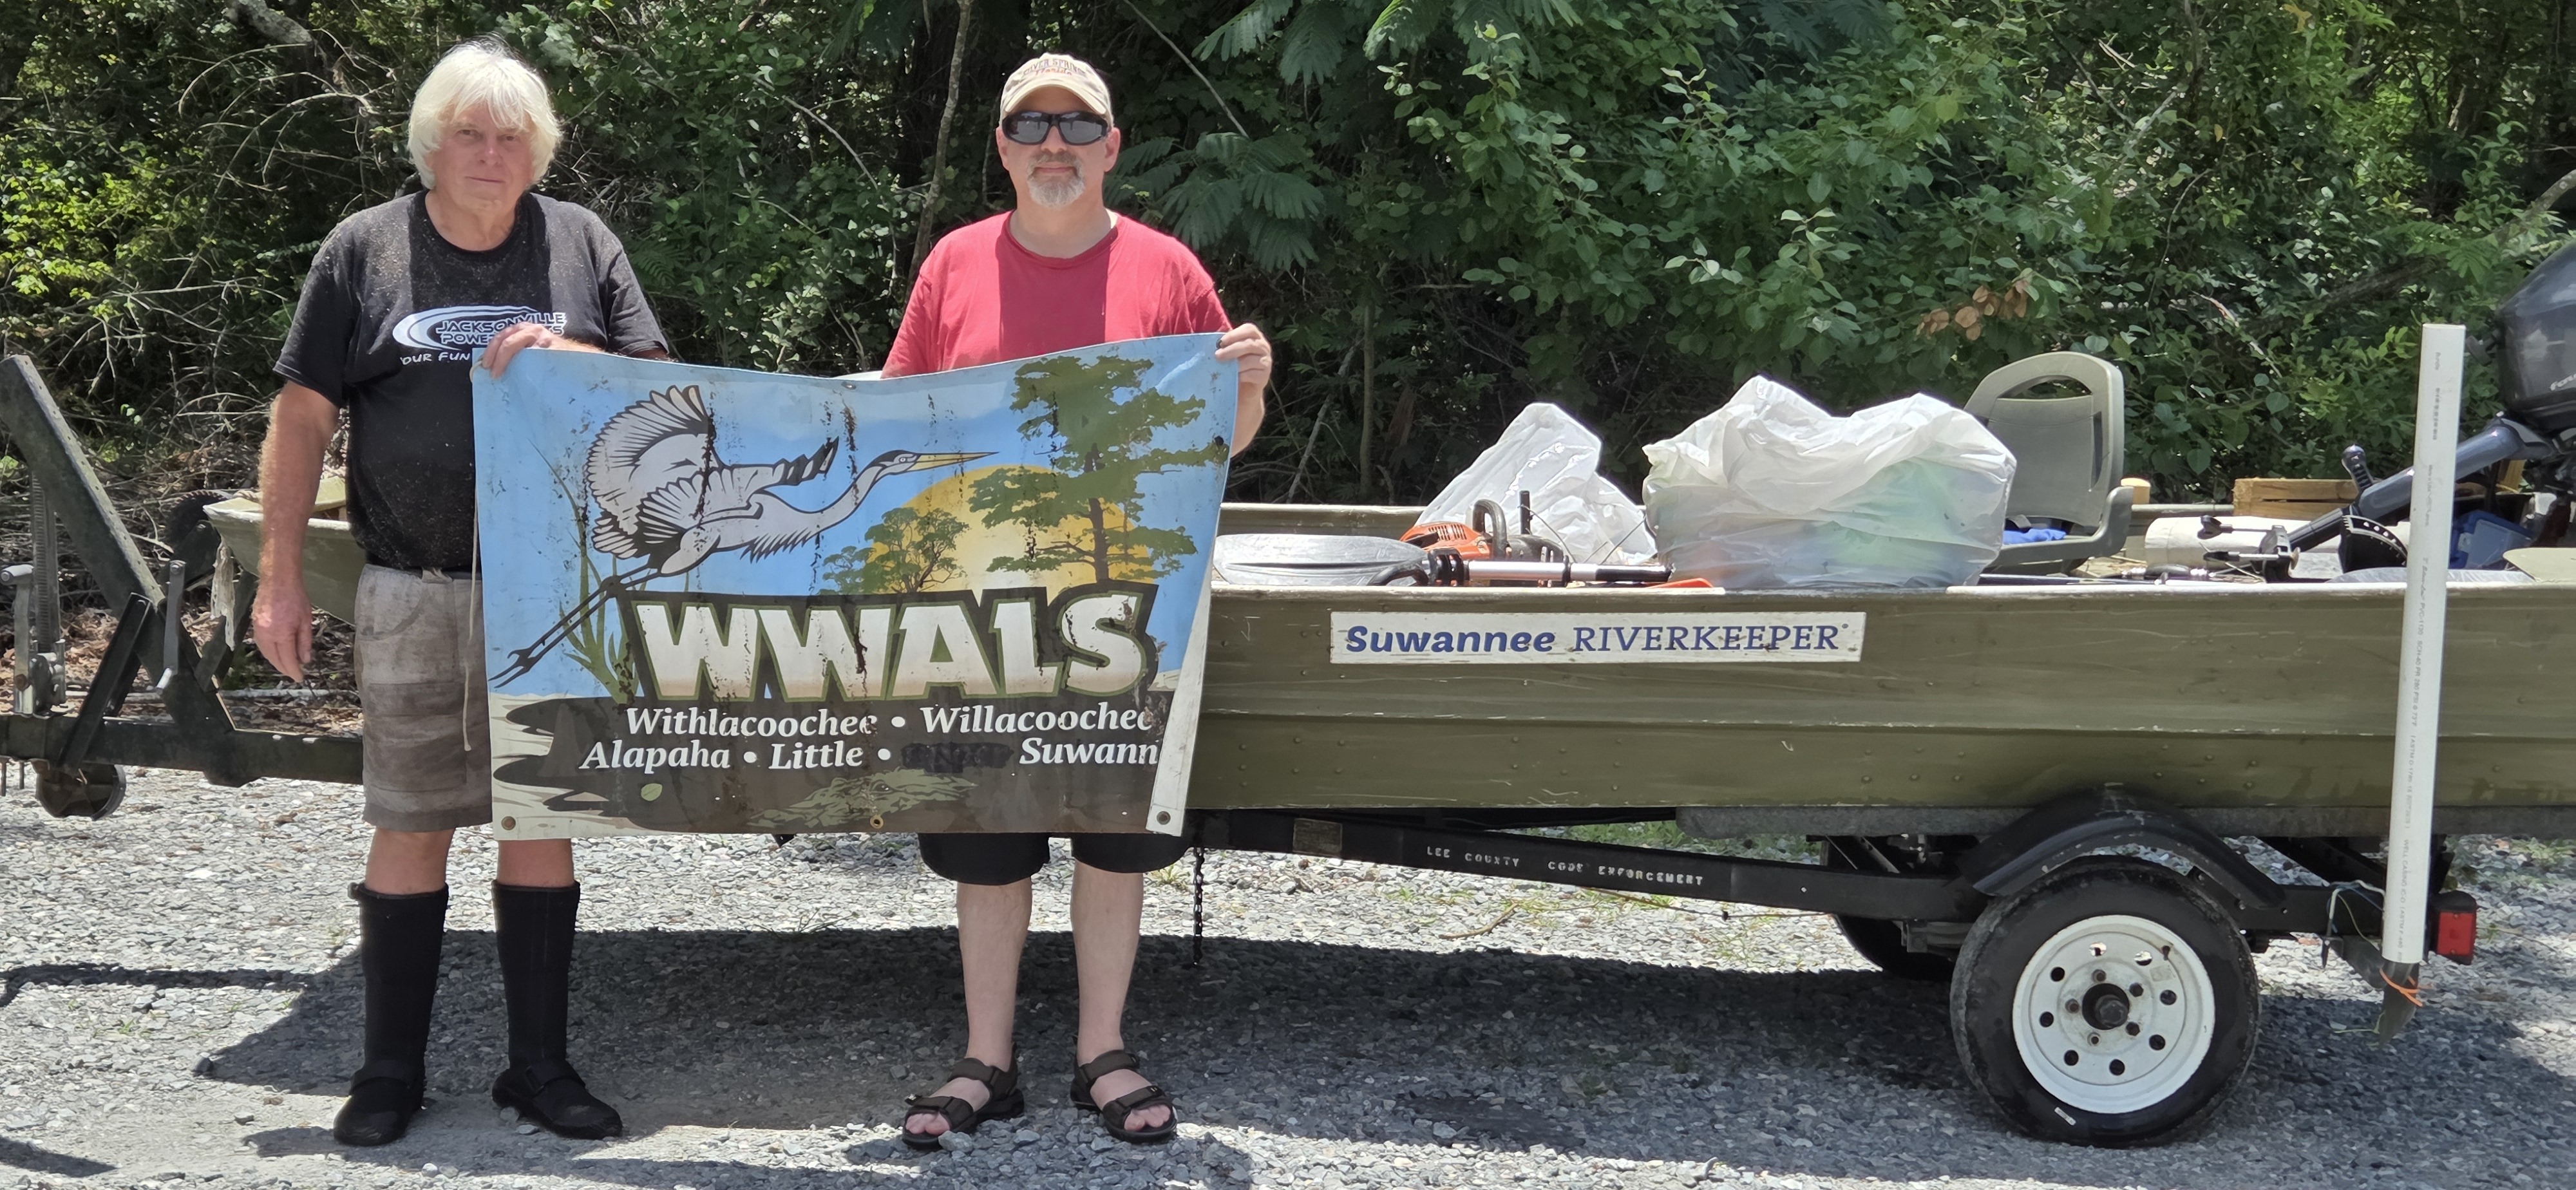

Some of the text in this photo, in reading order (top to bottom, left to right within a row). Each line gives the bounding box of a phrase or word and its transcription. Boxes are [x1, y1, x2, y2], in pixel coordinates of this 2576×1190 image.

[400, 352, 470, 365] OUR FUN
[632, 592, 1145, 701] WWALS
[1346, 625, 1556, 652] Suwannee
[626, 701, 1153, 737] Withlacoochee Willacoochee
[579, 739, 730, 774] Alapaha
[769, 740, 863, 770] Little
[1427, 845, 1703, 886] LEE COUNTY CODE ENFORCEMENT
